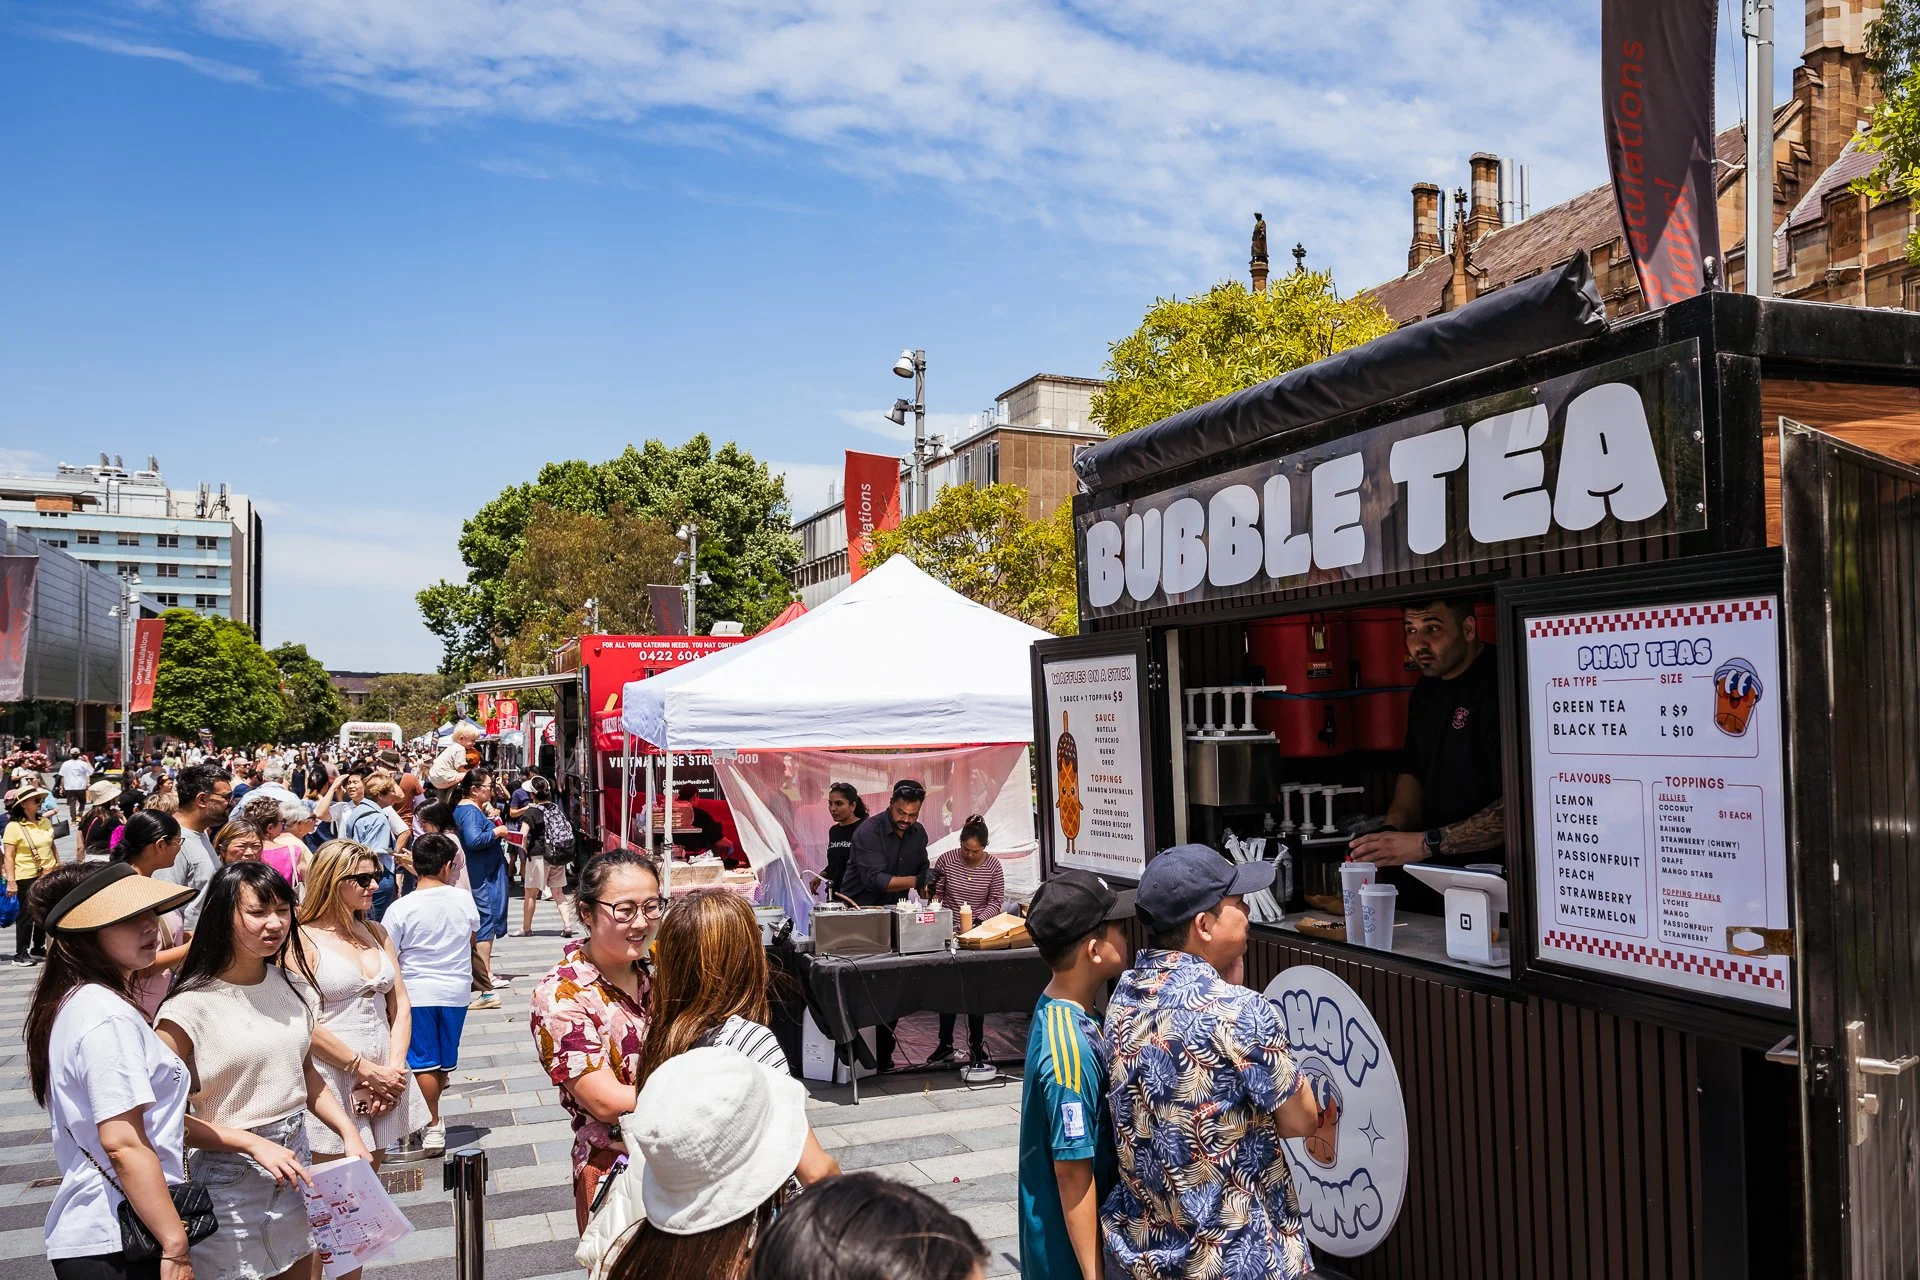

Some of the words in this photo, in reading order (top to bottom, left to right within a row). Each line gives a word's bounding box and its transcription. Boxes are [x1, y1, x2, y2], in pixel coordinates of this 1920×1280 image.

[1086, 451, 1365, 608] BUBBLE
[1389, 382, 1667, 555] TEA
[134, 631, 149, 686] Congratulations
[640, 651, 673, 661] 0422
[1578, 644, 1640, 670] PHAT
[1645, 638, 1712, 667] TEAS
[1051, 670, 1086, 685] WAFFLES
[1087, 669, 1099, 682] ON
[1101, 668, 1107, 681] A
[1108, 667, 1131, 681] STICK
[1552, 678, 1570, 687] TEA
[1573, 676, 1597, 687] TYPE
[1661, 674, 1682, 684] SIZE
[1113, 691, 1123, 702] $9
[1553, 701, 1594, 713] GREEN
[1600, 700, 1626, 712] TEA
[1661, 706, 1667, 717] R
[1672, 705, 1687, 717] $9
[1095, 713, 1115, 722] SAUCE
[1553, 724, 1596, 736] BLACK
[1602, 724, 1627, 736] TEA
[1661, 726, 1666, 736] L
[1672, 725, 1694, 738] $10
[1091, 775, 1122, 784] TOPPINGS
[1559, 773, 1611, 784] FLAVOURS
[1665, 776, 1725, 789] TOPPINGS
[1555, 795, 1593, 806] LEMON
[1556, 813, 1598, 825] LYCHEE
[1659, 815, 1686, 823] LYCHEE
[1719, 810, 1727, 819] $1
[1729, 811, 1752, 820] EACH
[1091, 819, 1111, 827] CRUSHED
[1090, 830, 1110, 838] CRUSHED
[1111, 832, 1134, 841] ALMONDS
[1660, 826, 1692, 834] RAINBOW
[1557, 831, 1599, 844] MANGO
[1661, 836, 1705, 846] STRAWBERRY
[1708, 839, 1740, 850] (CHEWY)
[1558, 850, 1640, 867] PASSIONFRUIT
[1661, 846, 1705, 857] STRAWBERRY
[1708, 850, 1736, 859] HEARTS
[1662, 857, 1683, 865] GRAPE
[1559, 868, 1594, 881] PEACH
[1662, 867, 1688, 876] MANGO
[1691, 870, 1713, 879] STARS
[1560, 886, 1632, 905] STRAWBERRY
[1662, 888, 1692, 898] POPPING
[1695, 891, 1721, 901] PEARLS
[1663, 899, 1689, 907] LYCHEE
[1560, 904, 1636, 924] WATERMELON
[1663, 909, 1689, 918] MANGO
[1663, 920, 1714, 933] PASSIONFRUIT
[1664, 930, 1709, 943] STRAWBERRY
